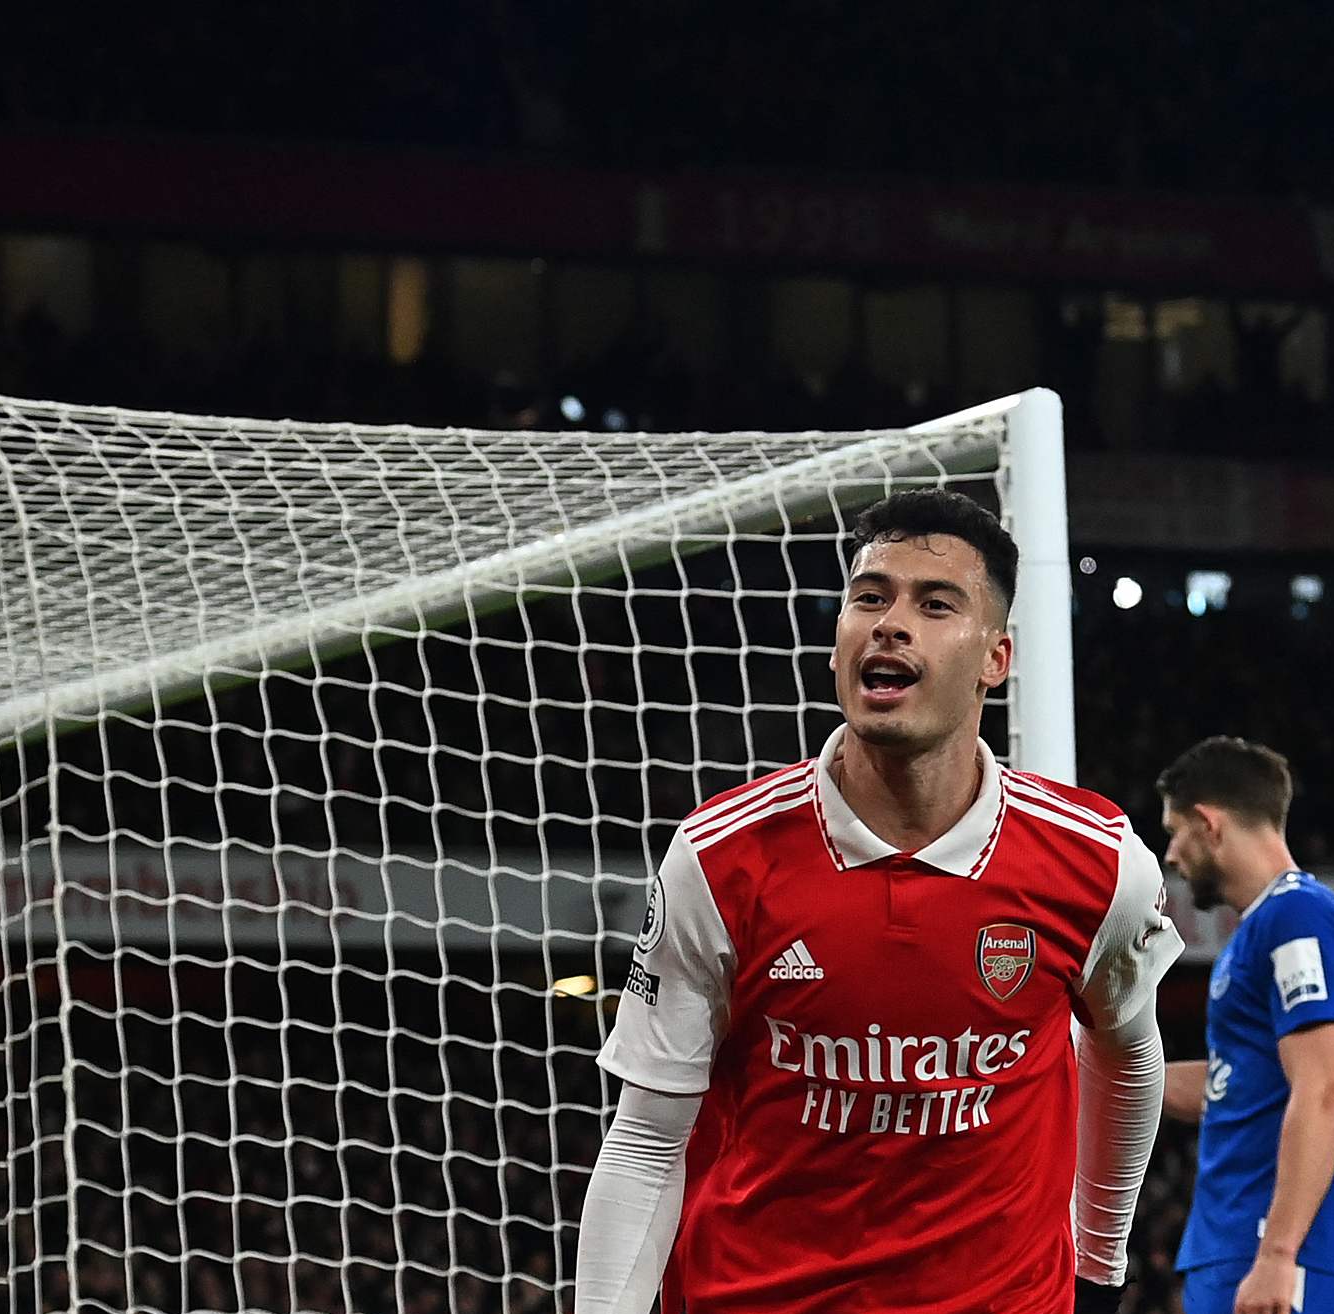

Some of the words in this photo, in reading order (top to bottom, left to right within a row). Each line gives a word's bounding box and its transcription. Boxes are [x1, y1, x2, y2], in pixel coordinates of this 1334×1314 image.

[984, 936, 1028, 950] Arsenal
[768, 964, 824, 980] adidas
[763, 1014, 1031, 1083] Emirates
[801, 1083, 857, 1134] FLY
[869, 1085, 995, 1136] BETTER
